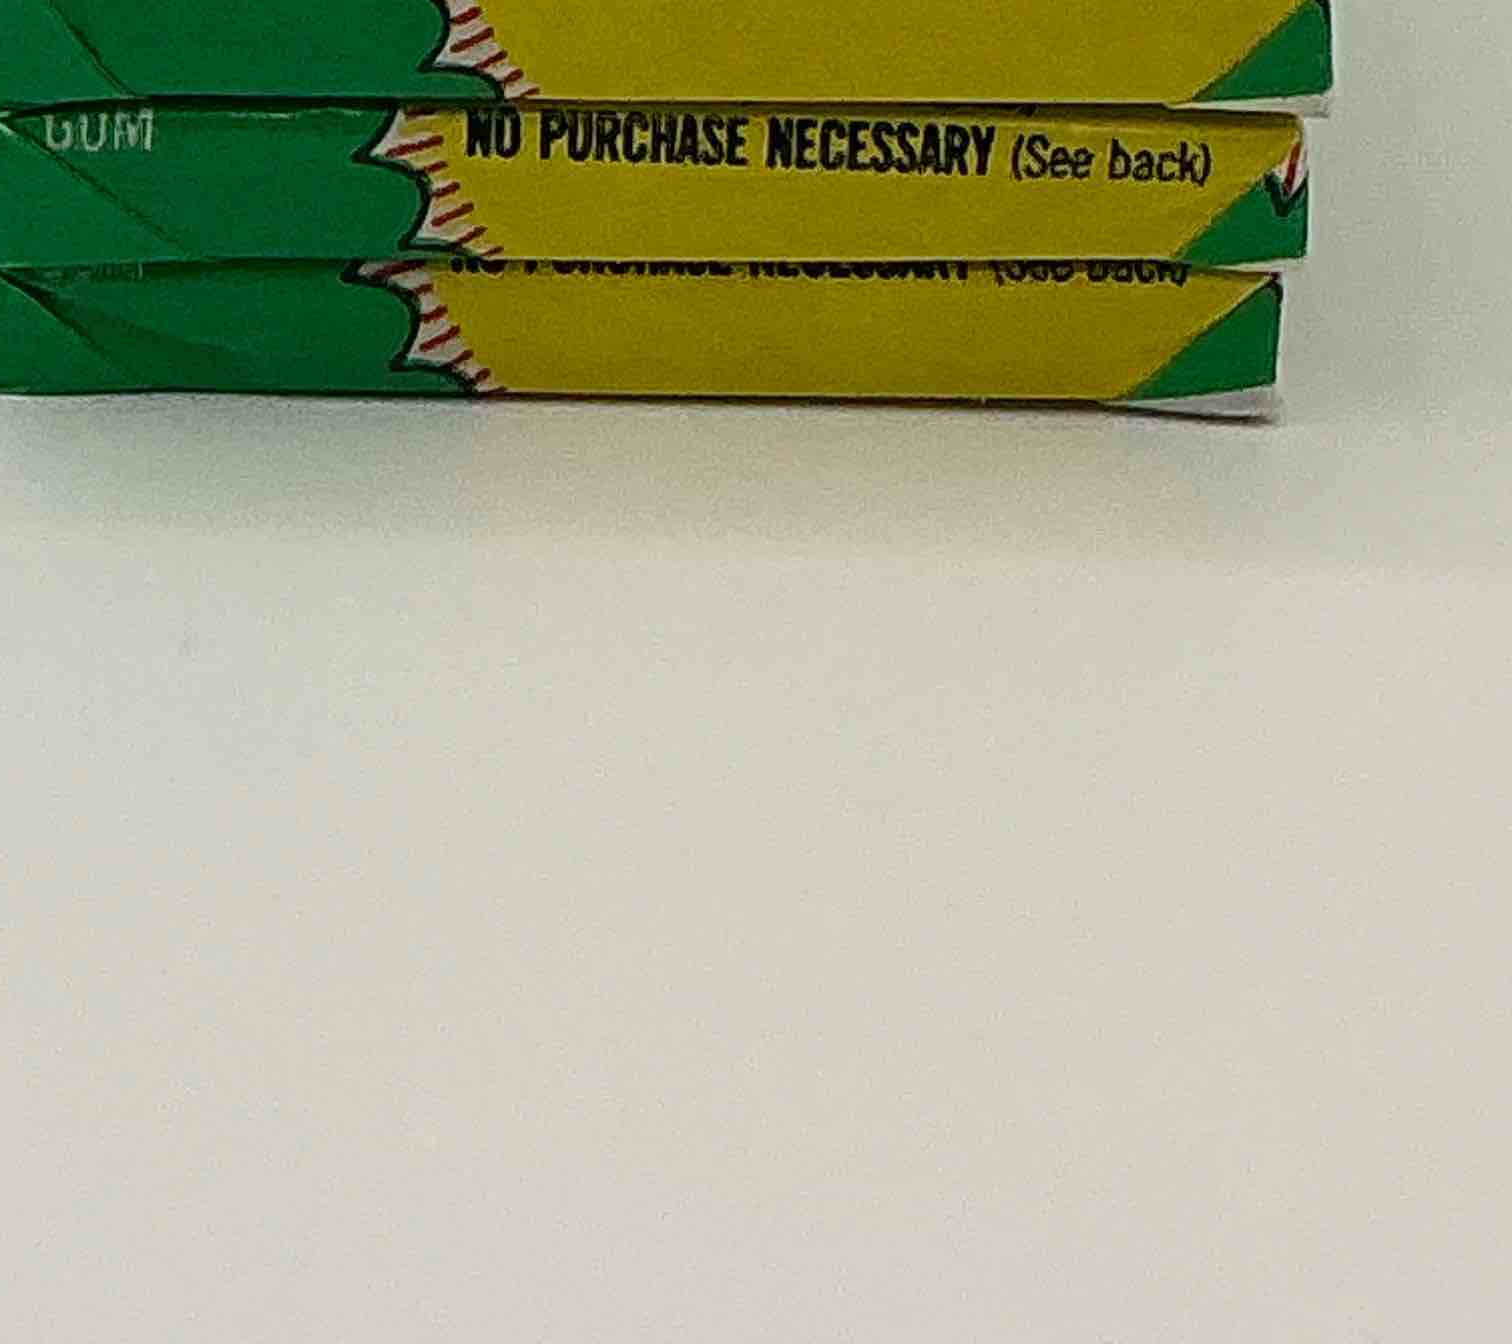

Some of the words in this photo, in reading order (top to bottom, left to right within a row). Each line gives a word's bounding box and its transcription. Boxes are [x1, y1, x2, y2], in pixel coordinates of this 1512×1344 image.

[466, 114, 522, 161] NO
[540, 114, 750, 168] PURCHASE
[767, 119, 996, 176] NECESSARY
[1012, 136, 1092, 180] (See
[1108, 139, 1214, 185] back)
